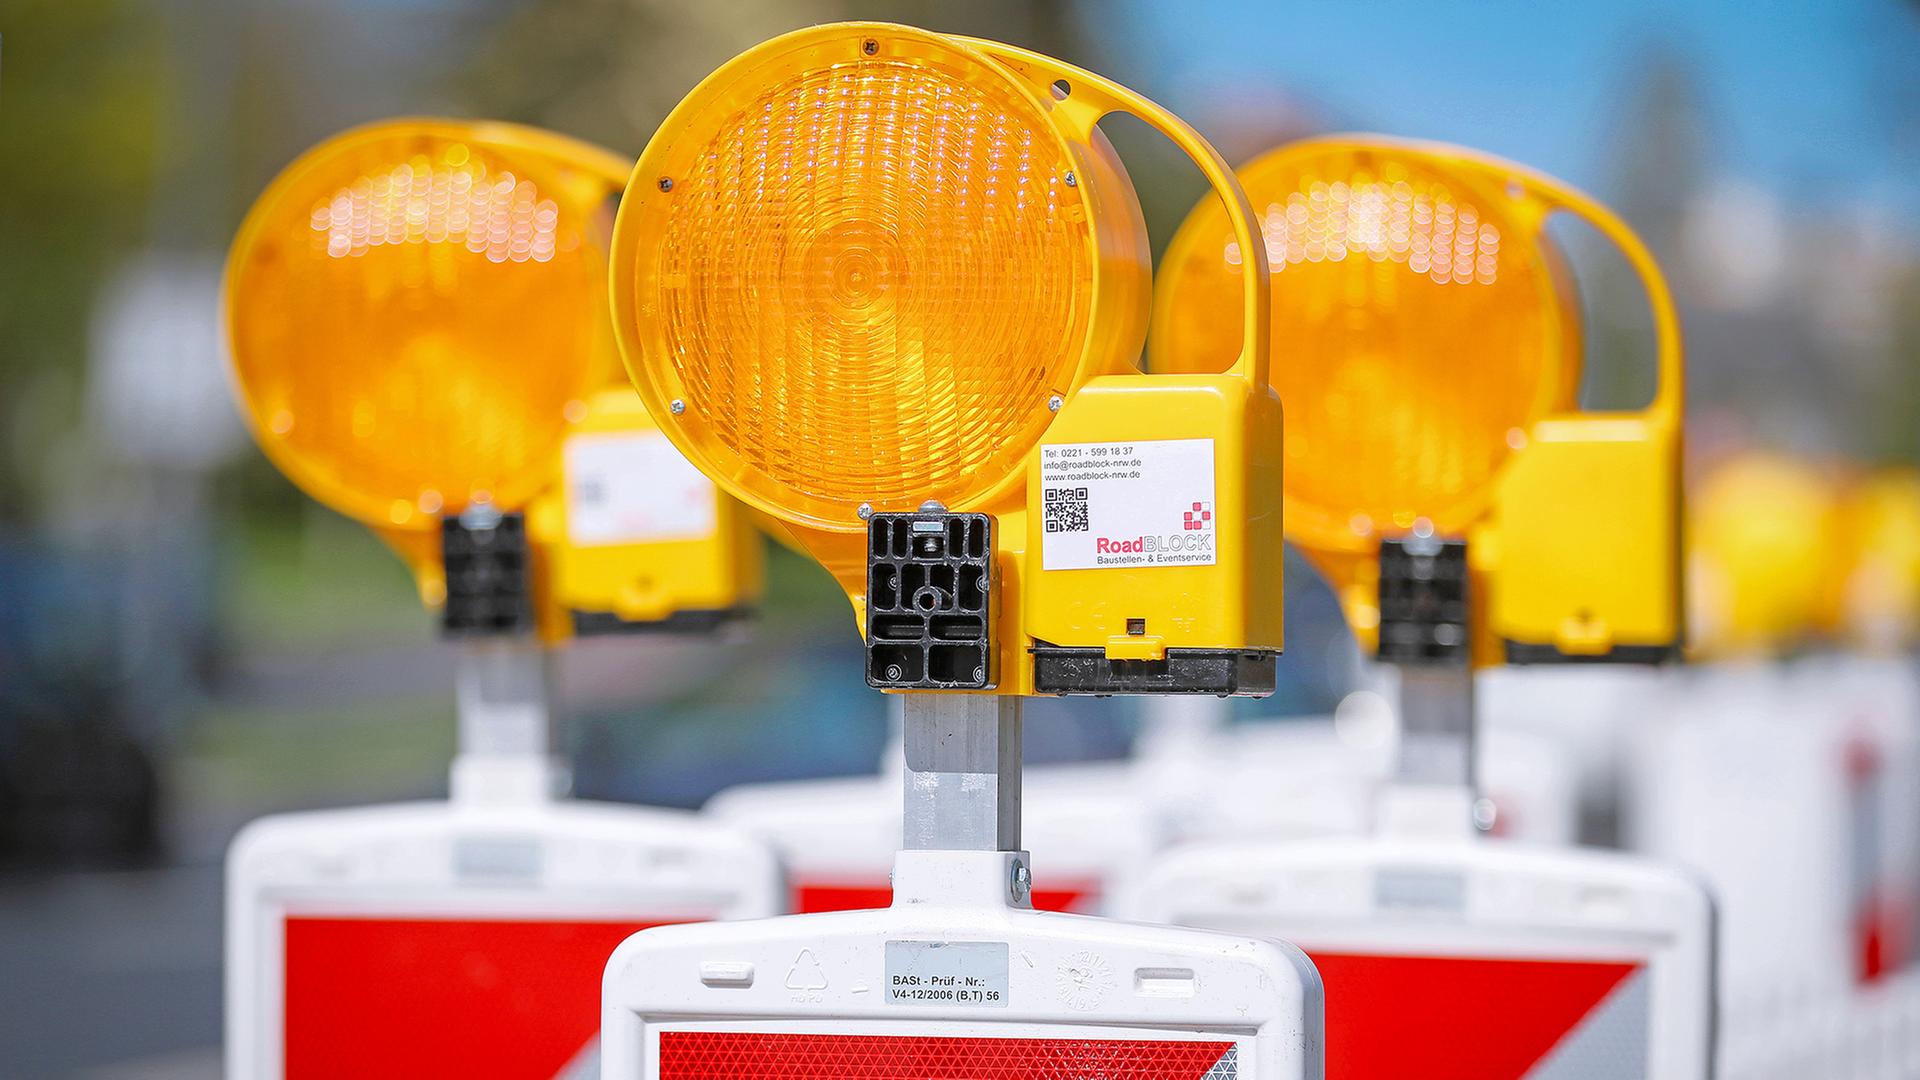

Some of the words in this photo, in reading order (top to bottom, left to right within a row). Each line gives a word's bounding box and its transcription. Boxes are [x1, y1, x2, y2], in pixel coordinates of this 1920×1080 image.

[1044, 449, 1059, 458] Tel:
[1061, 449, 1082, 458] 0221
[1091, 447, 1107, 456] 599
[1110, 447, 1121, 456] 18
[1123, 446, 1134, 455] 37
[1044, 459, 1142, 471] info@roadblock-nrw.de
[1044, 471, 1141, 481] www.roadblock-nrw.de
[1097, 534, 1212, 554] RoadBLOCK
[1097, 555, 1146, 565] Baustellen-
[1147, 555, 1154, 563] &
[1156, 554, 1212, 563] Eventservice
[892, 975, 921, 986] BASt
[931, 976, 956, 986] Prüf
[965, 976, 985, 987] Nr.:
[892, 989, 953, 1000] V4-12/2006
[956, 990, 983, 1003] (B,T)
[986, 991, 1000, 1001] 56
